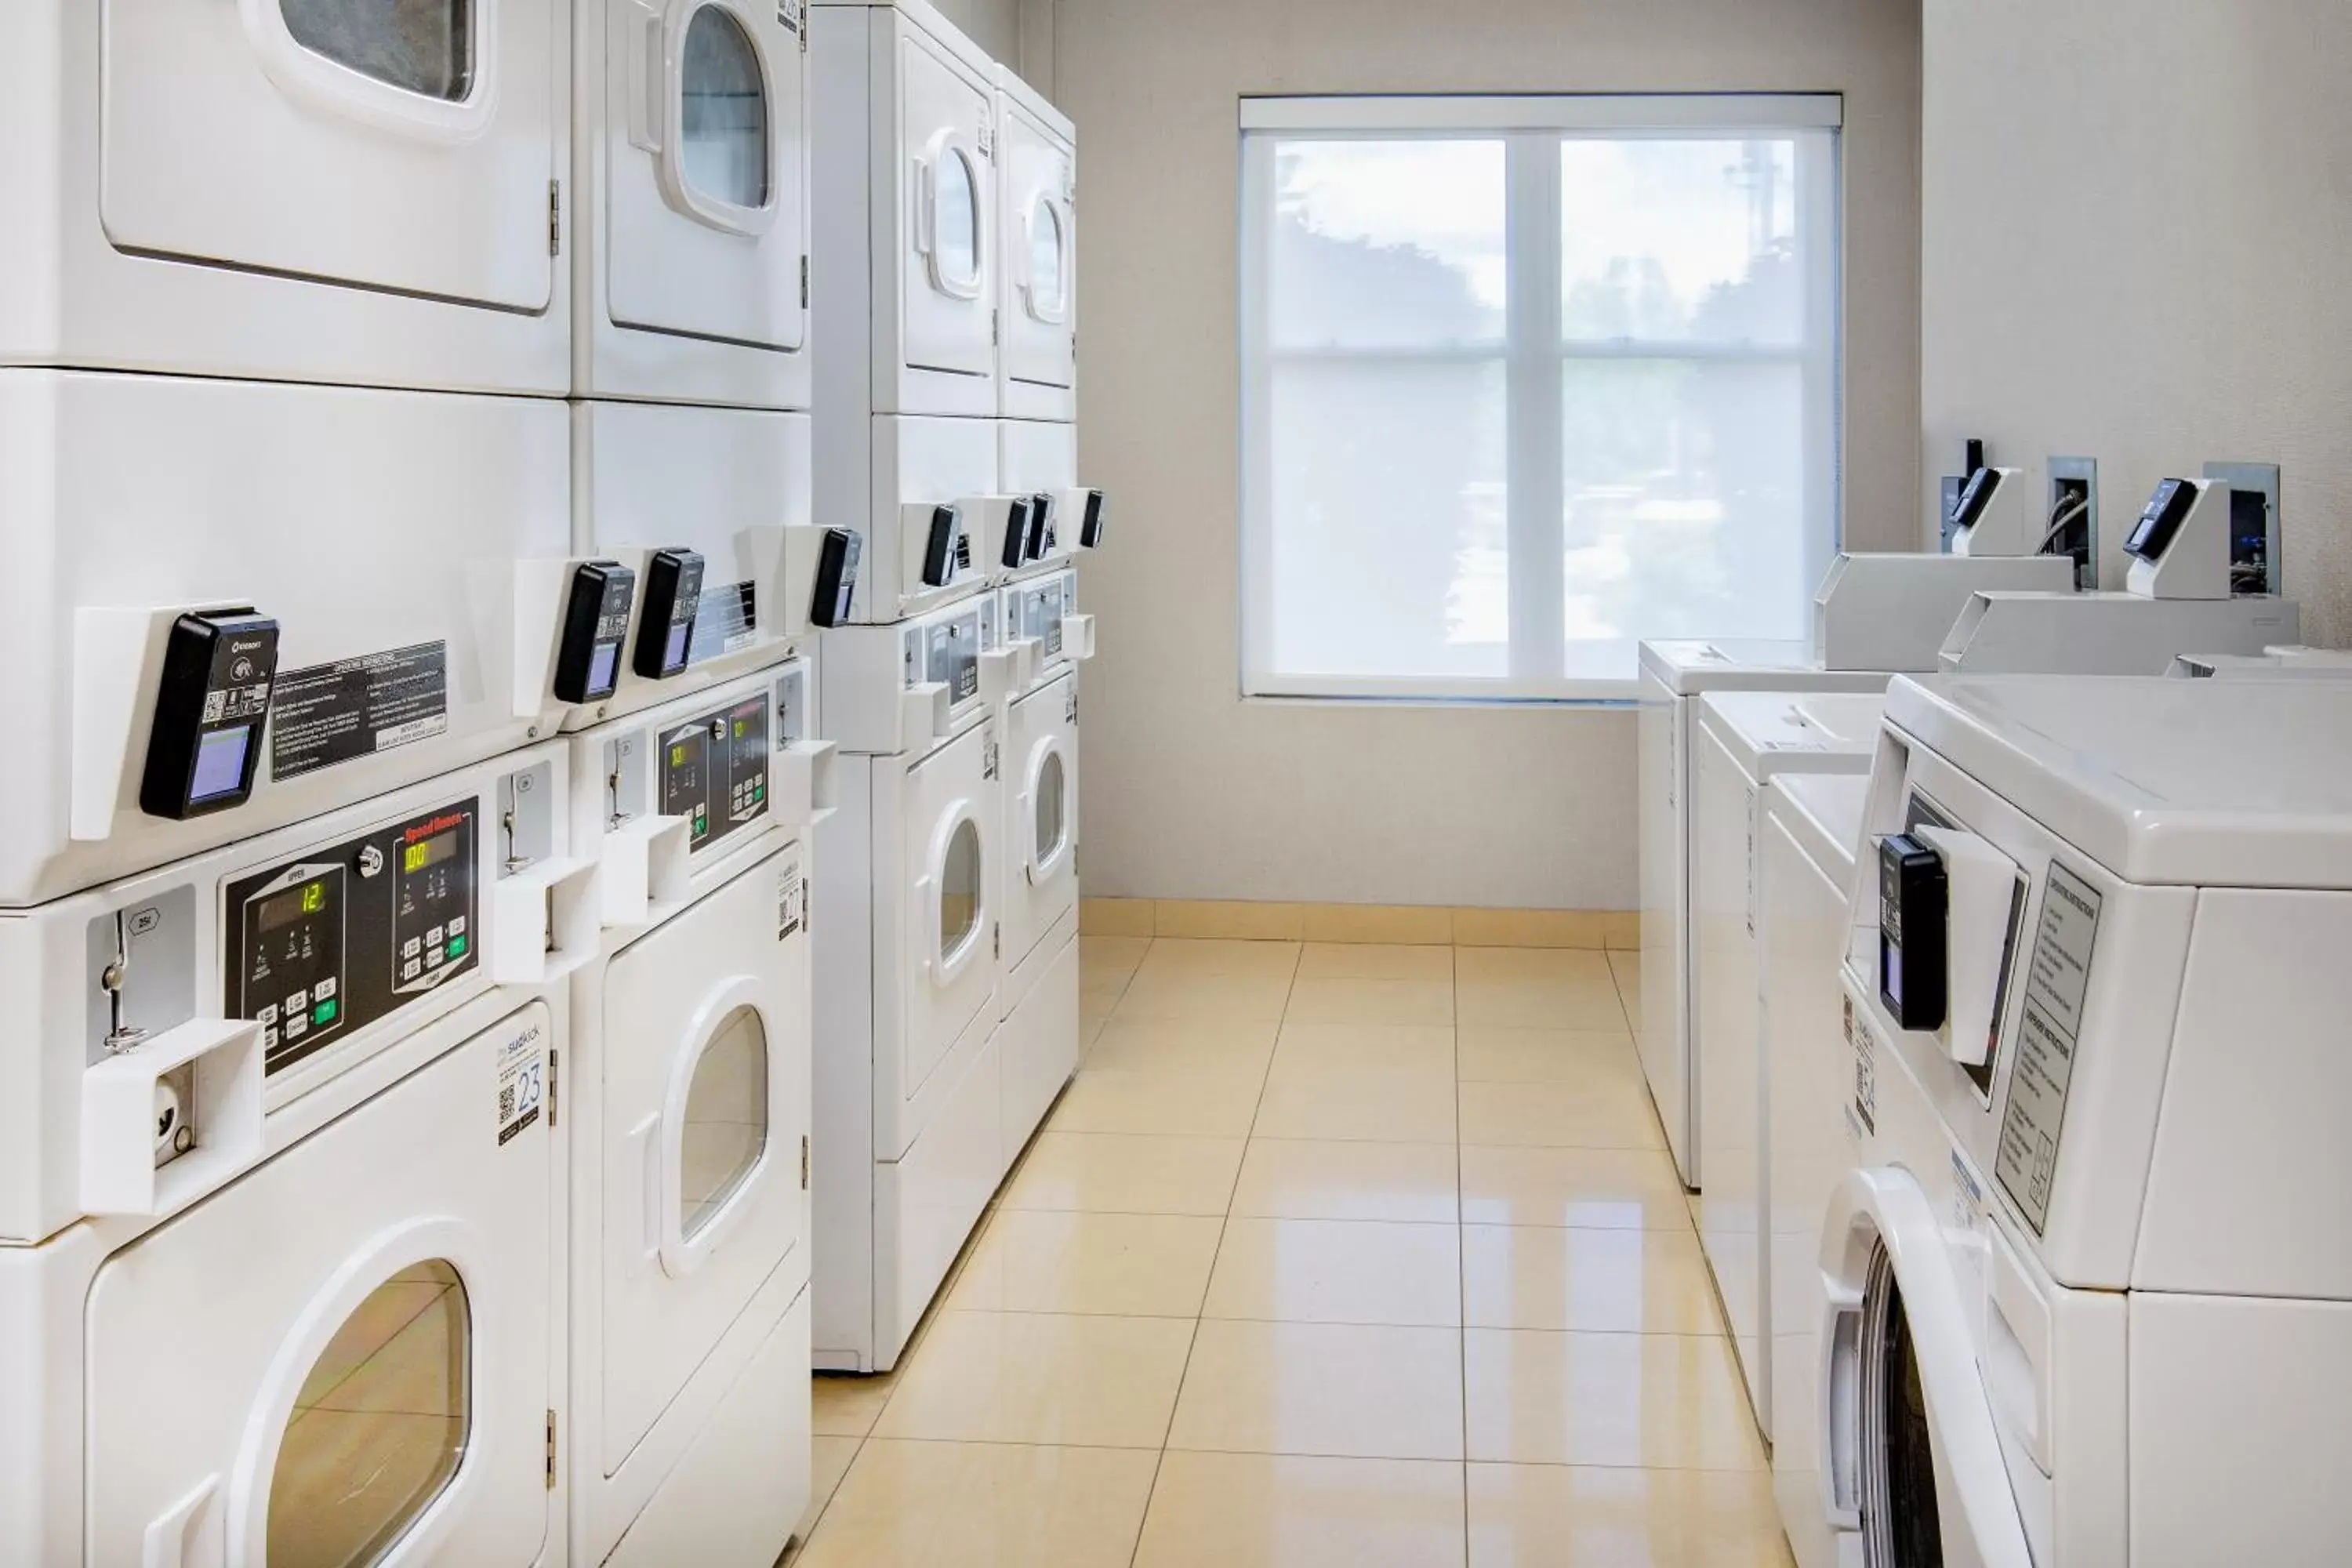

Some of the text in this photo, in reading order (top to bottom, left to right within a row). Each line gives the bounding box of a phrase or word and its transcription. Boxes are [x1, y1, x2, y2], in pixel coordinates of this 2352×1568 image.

[405, 813, 462, 844] Speed Queen
[289, 868, 305, 882] UPPER
[303, 883, 319, 913] 12
[518, 1062, 541, 1112] 23
